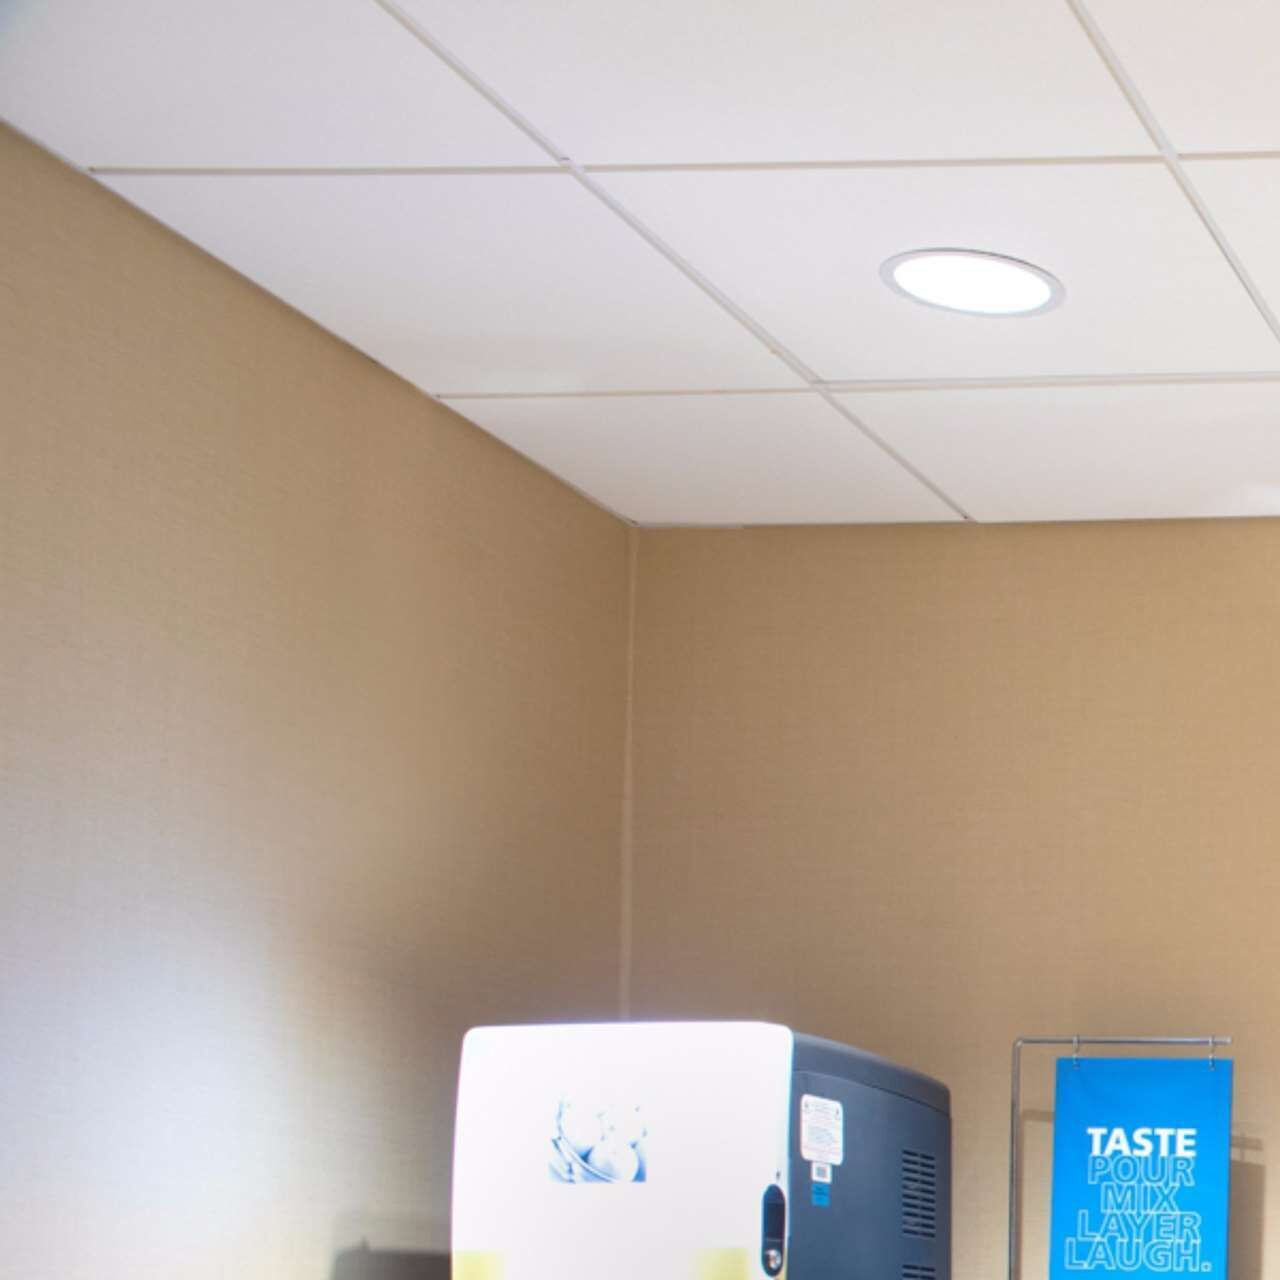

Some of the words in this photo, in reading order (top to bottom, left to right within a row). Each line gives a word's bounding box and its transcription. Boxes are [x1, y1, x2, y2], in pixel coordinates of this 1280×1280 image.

[1087, 1127, 1198, 1157] TASTE
[1087, 1154, 1196, 1186] POUR
[1100, 1182, 1179, 1213] MIX
[1077, 1209, 1202, 1243] LAYER
[1064, 1237, 1213, 1272] LAUGH.
